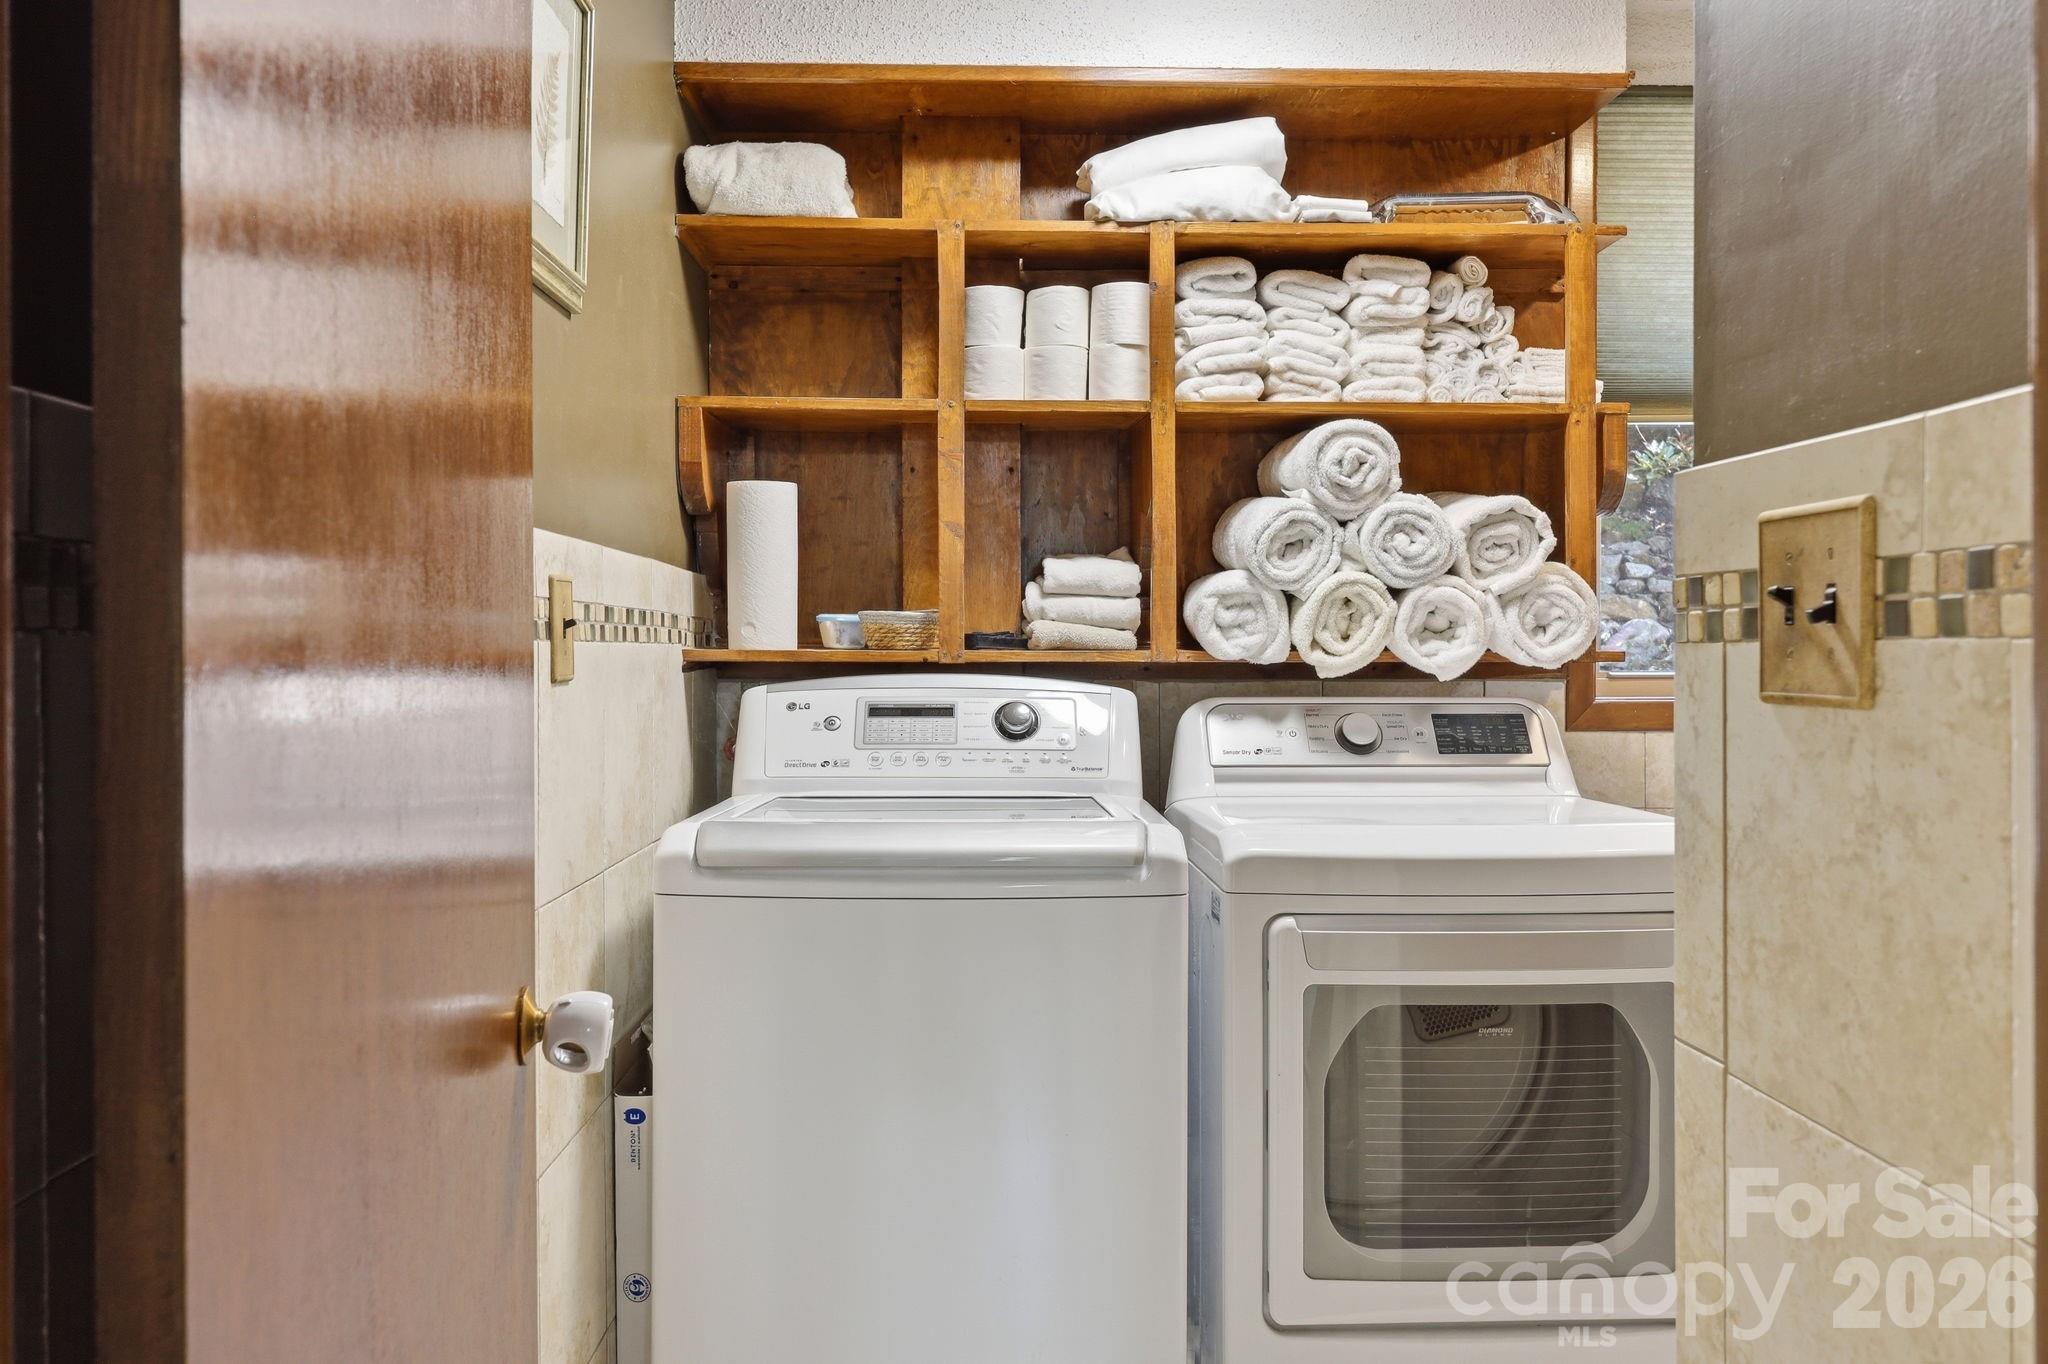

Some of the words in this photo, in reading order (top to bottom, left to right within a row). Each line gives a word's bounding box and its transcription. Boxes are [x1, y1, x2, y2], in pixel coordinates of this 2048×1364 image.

[798, 702, 811, 710] LG
[1241, 749, 1252, 757] Dry
[629, 1113, 641, 1121] E
